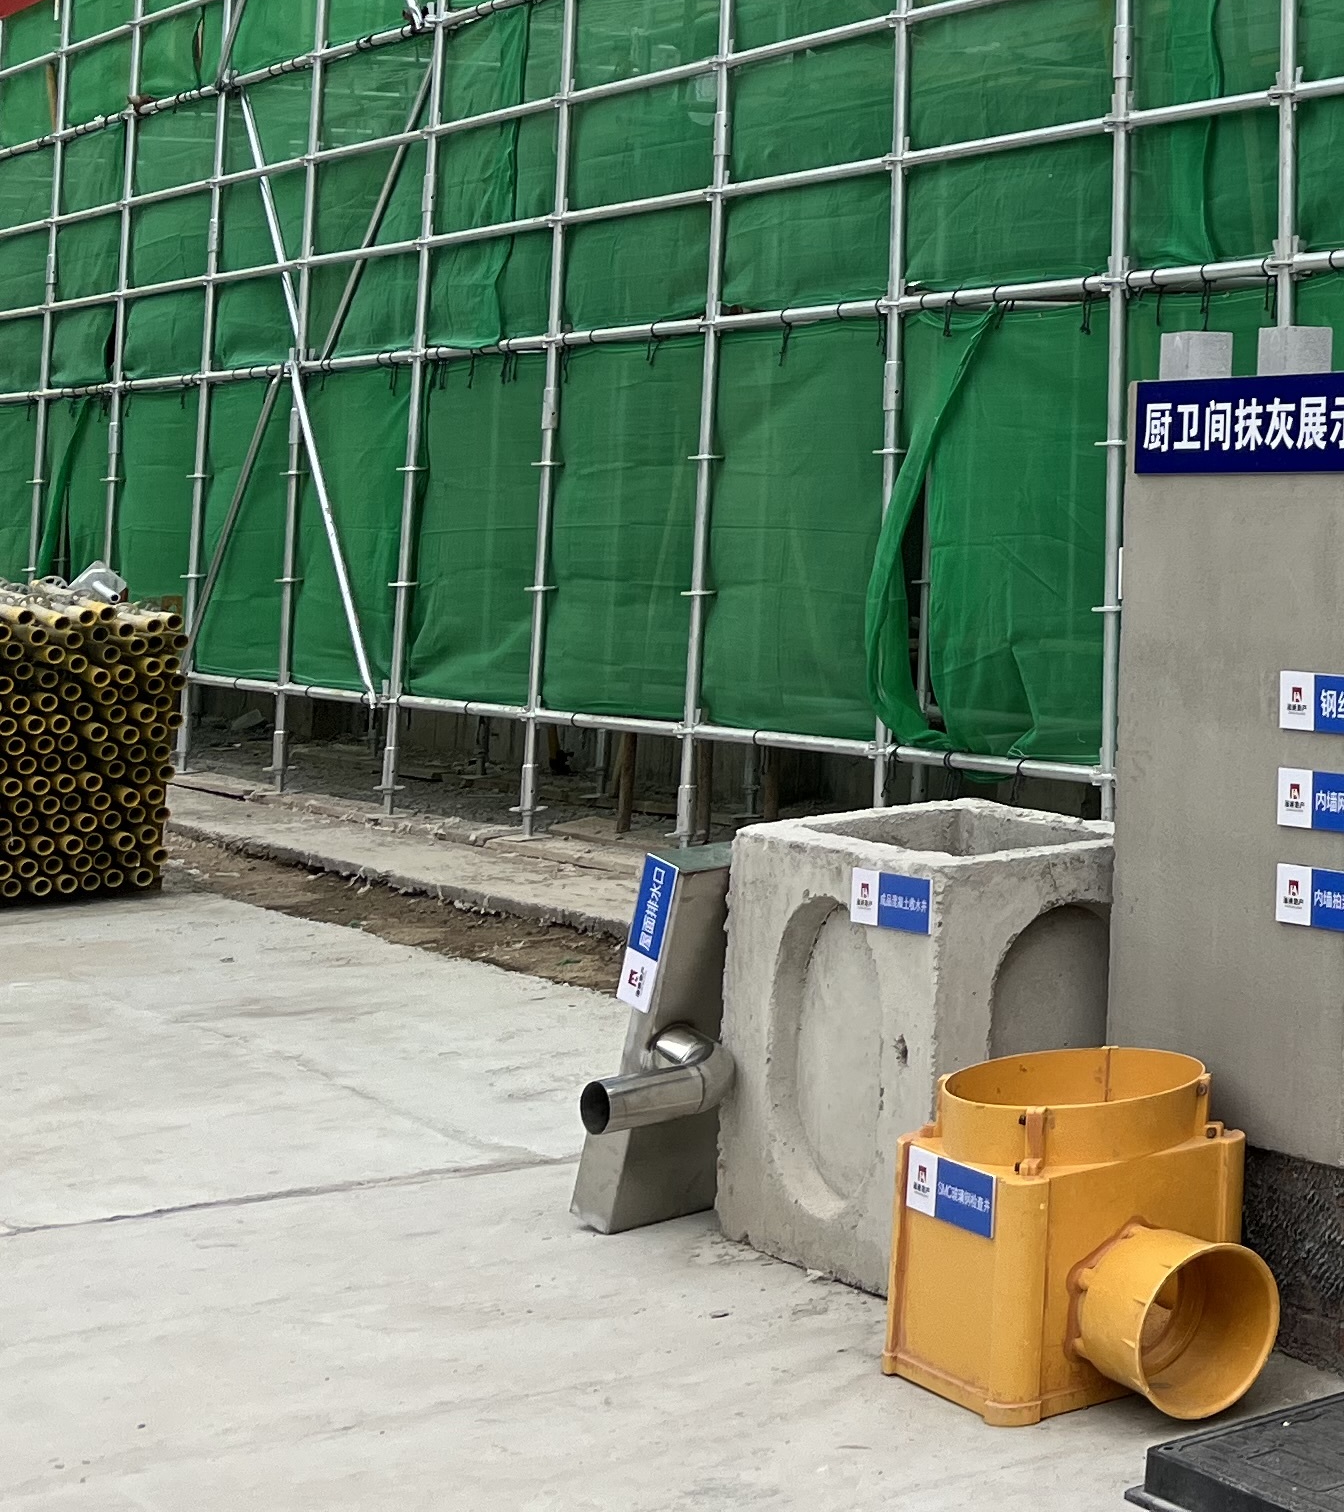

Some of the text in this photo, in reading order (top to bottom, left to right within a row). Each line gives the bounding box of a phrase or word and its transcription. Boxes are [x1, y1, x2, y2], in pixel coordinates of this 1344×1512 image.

[638, 866, 666, 952] 屋面排水口
